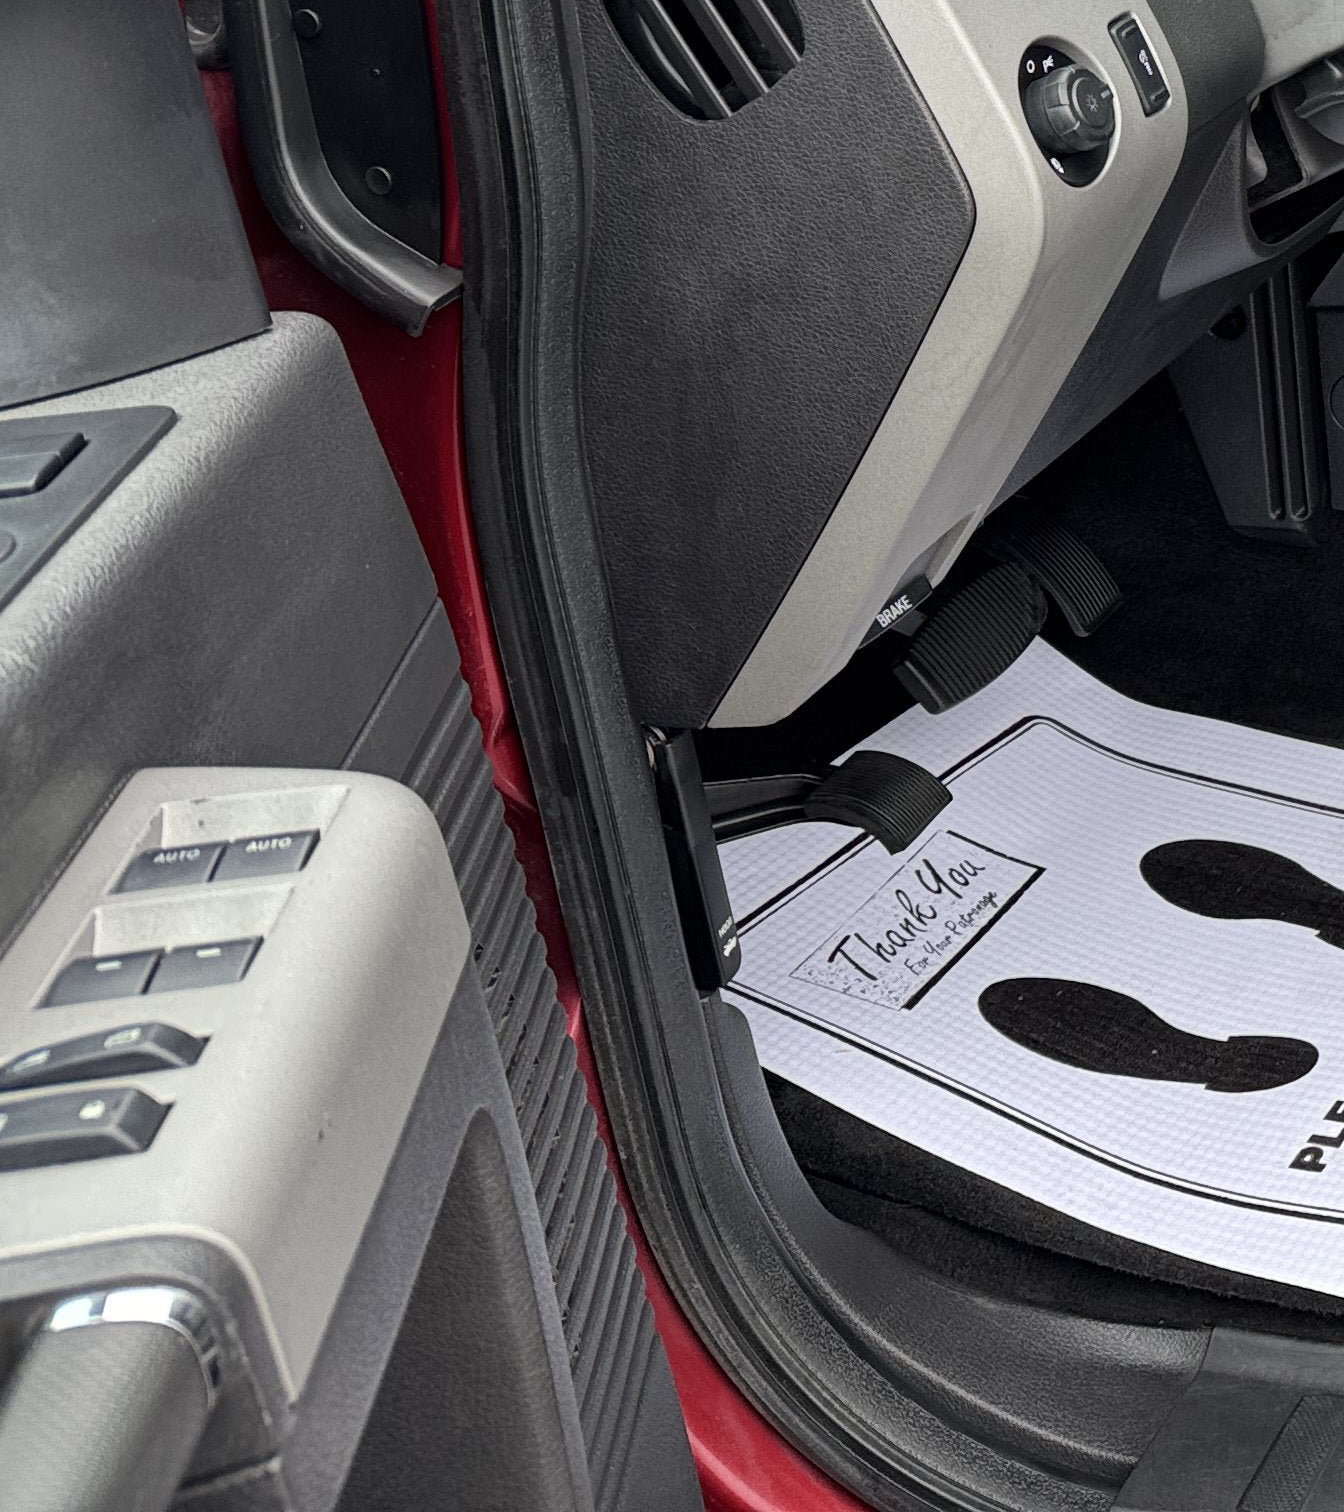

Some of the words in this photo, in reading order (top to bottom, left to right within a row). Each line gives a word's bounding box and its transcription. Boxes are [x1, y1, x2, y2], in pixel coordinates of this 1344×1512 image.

[874, 594, 913, 628] BRAKE
[153, 848, 201, 864] AUTO
[245, 838, 292, 854] AUTO
[827, 888, 938, 981] Thank
[914, 858, 987, 900] You
[903, 957, 930, 977] For
[922, 934, 953, 956] Your
[944, 891, 999, 936] Patronage
